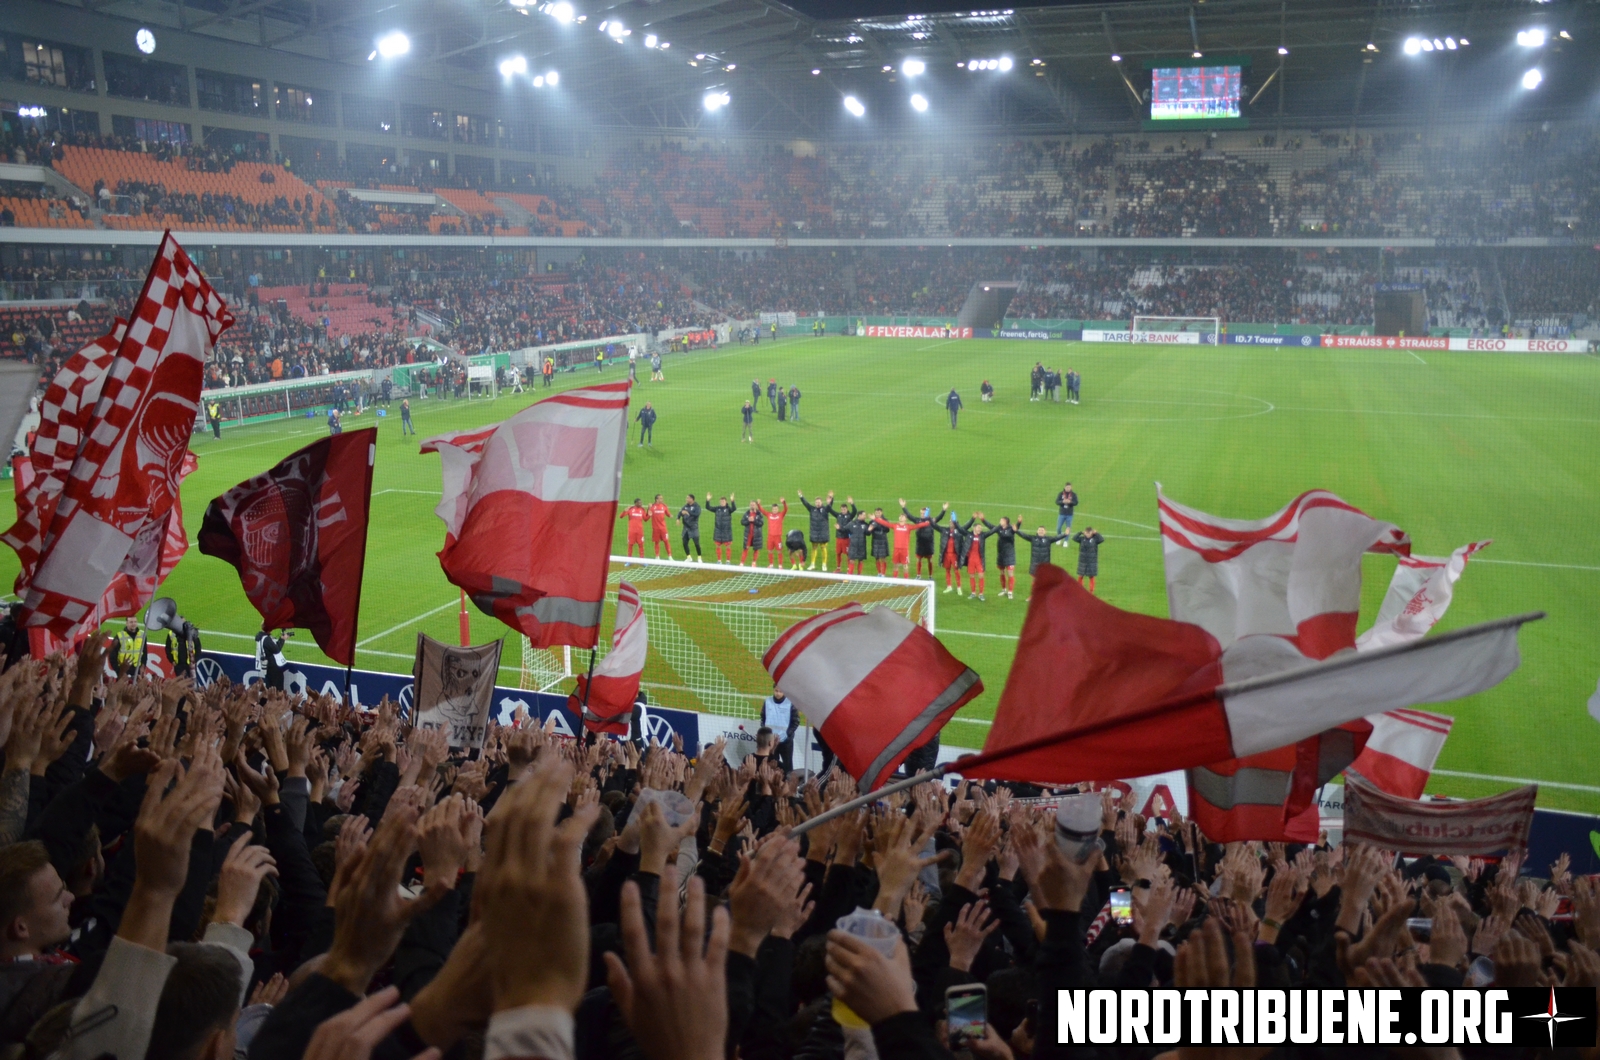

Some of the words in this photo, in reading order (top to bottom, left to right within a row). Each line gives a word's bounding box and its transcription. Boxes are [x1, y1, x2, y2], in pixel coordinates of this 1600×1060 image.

[877, 326, 959, 338] FLYERALARM
[1235, 335, 1253, 343] ID.7
[1254, 335, 1283, 344] Tourer
[1337, 337, 1382, 347] STRAUSS
[1399, 338, 1446, 348] STRAUSS
[1467, 339, 1506, 350] ERGO
[1528, 340, 1568, 351] ERGO
[722, 731, 753, 742] TARGO
